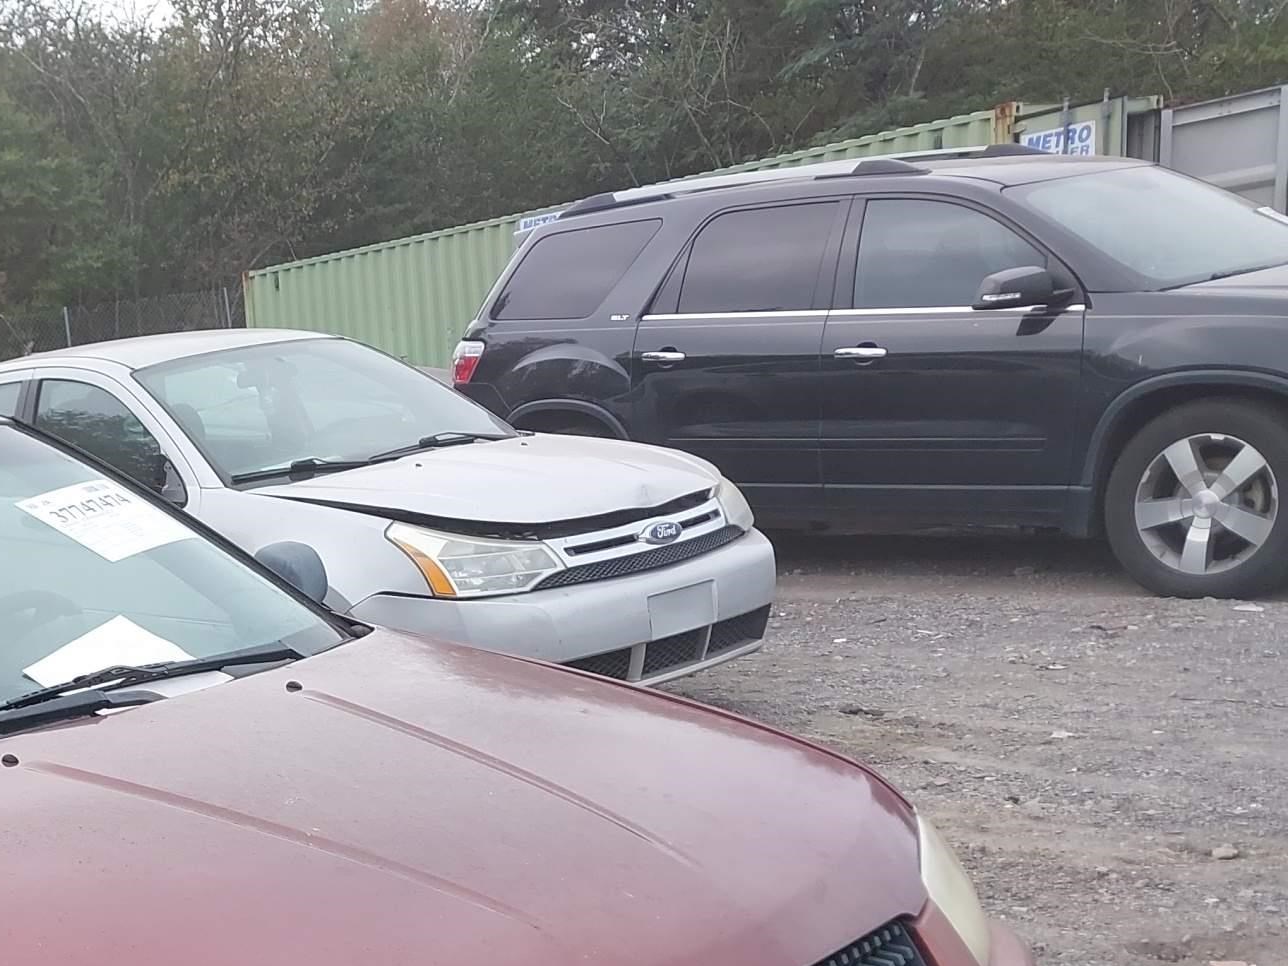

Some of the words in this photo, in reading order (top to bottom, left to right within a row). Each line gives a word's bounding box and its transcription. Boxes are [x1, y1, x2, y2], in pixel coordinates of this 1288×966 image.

[1027, 125, 1092, 150] METRO
[49, 492, 131, 523] 37747474
[656, 524, 677, 538] Ford
